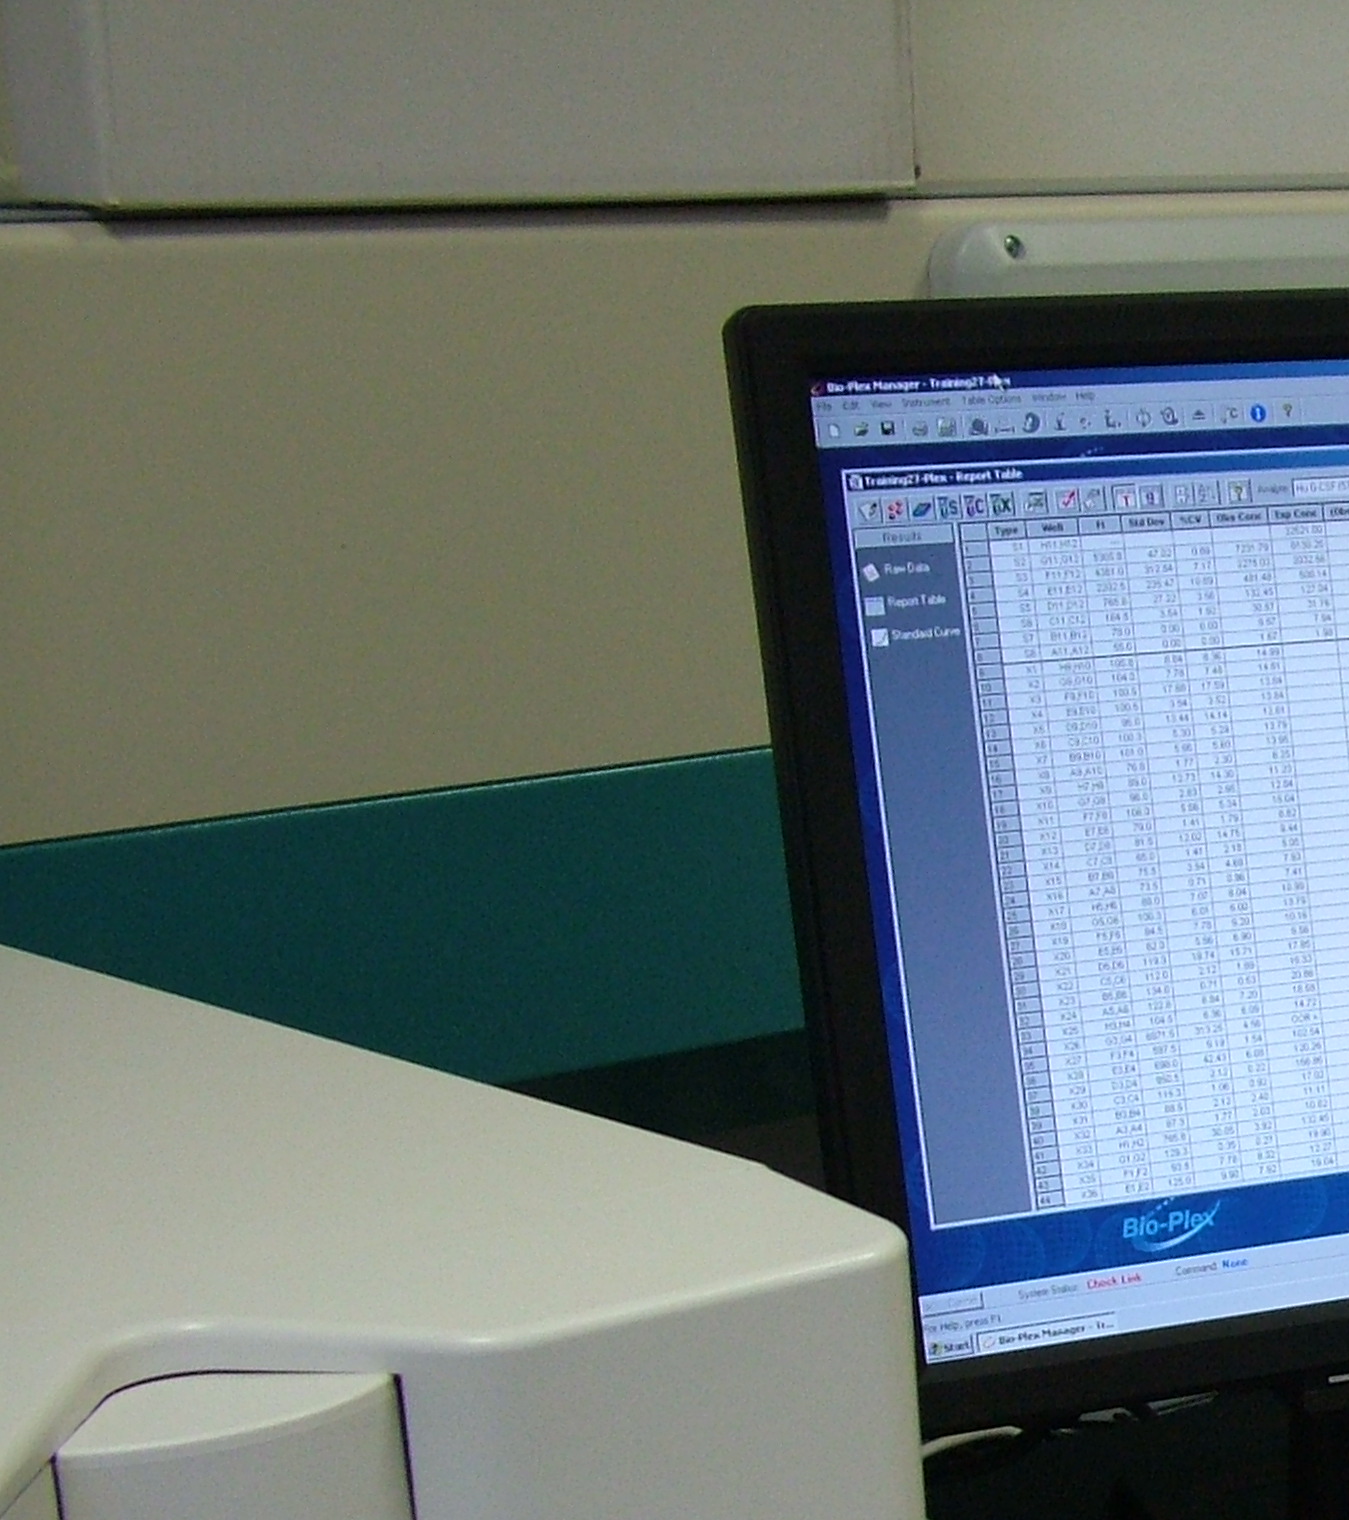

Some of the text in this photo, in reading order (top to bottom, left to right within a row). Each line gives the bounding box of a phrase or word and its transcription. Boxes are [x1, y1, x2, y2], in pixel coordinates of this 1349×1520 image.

[827, 380, 871, 394] Bio-Plex
[873, 378, 921, 392] Manager
[902, 396, 952, 408] Instrument
[988, 393, 1022, 406] Options
[865, 467, 1023, 488] Training27-Plex Report Table
[881, 532, 922, 543] Results
[993, 524, 1018, 536] Type
[884, 561, 930, 574] Raw Data
[887, 594, 946, 608] Report Table
[891, 626, 961, 641] Standard Curve
[1122, 1208, 1215, 1239] Bio-Plex
[1222, 1257, 1248, 1269] None
[1086, 1275, 1118, 1290] Check
[1121, 1272, 1142, 1284] Link
[964, 1316, 989, 1329] press
[944, 1340, 970, 1351] Start
[1042, 1324, 1086, 1339] Manager
